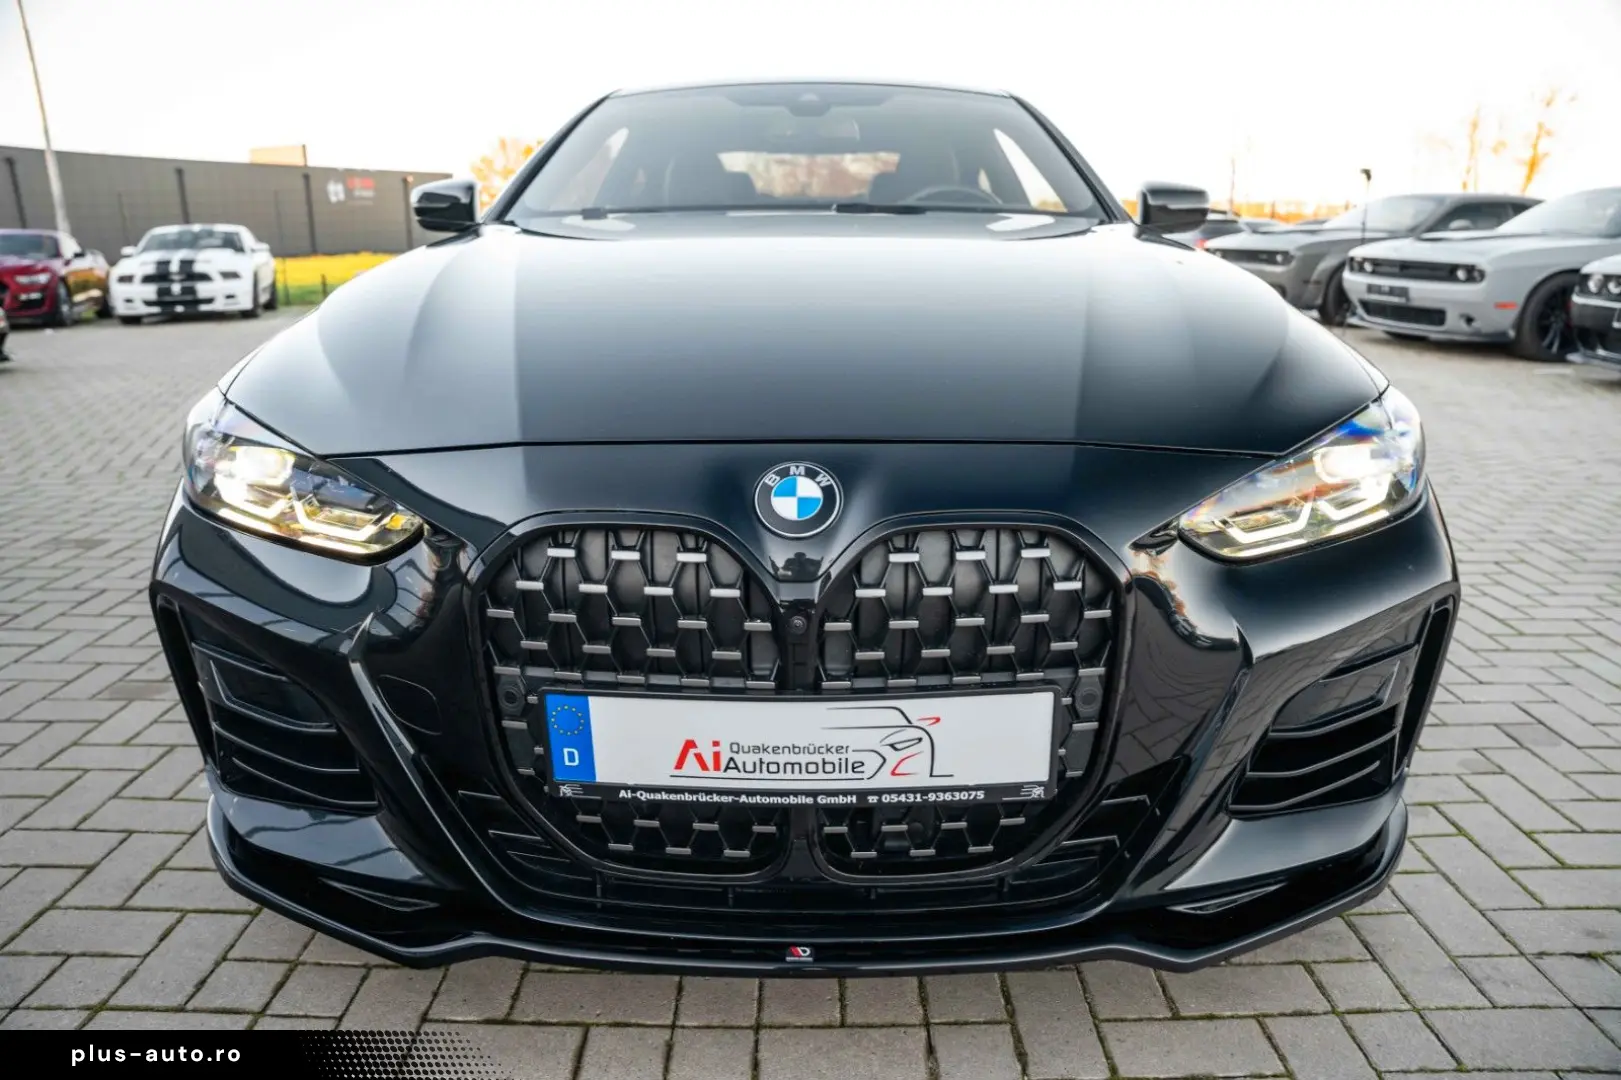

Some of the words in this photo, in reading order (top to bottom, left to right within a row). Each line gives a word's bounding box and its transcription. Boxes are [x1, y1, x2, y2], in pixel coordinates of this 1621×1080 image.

[764, 465, 832, 487] BMW
[563, 747, 579, 766] D
[673, 739, 721, 772] Ai
[729, 742, 850, 755] Quakenbrücker
[723, 757, 865, 775] Automobile
[817, 795, 856, 805] GmbH
[882, 791, 984, 803] 05431-9363075
